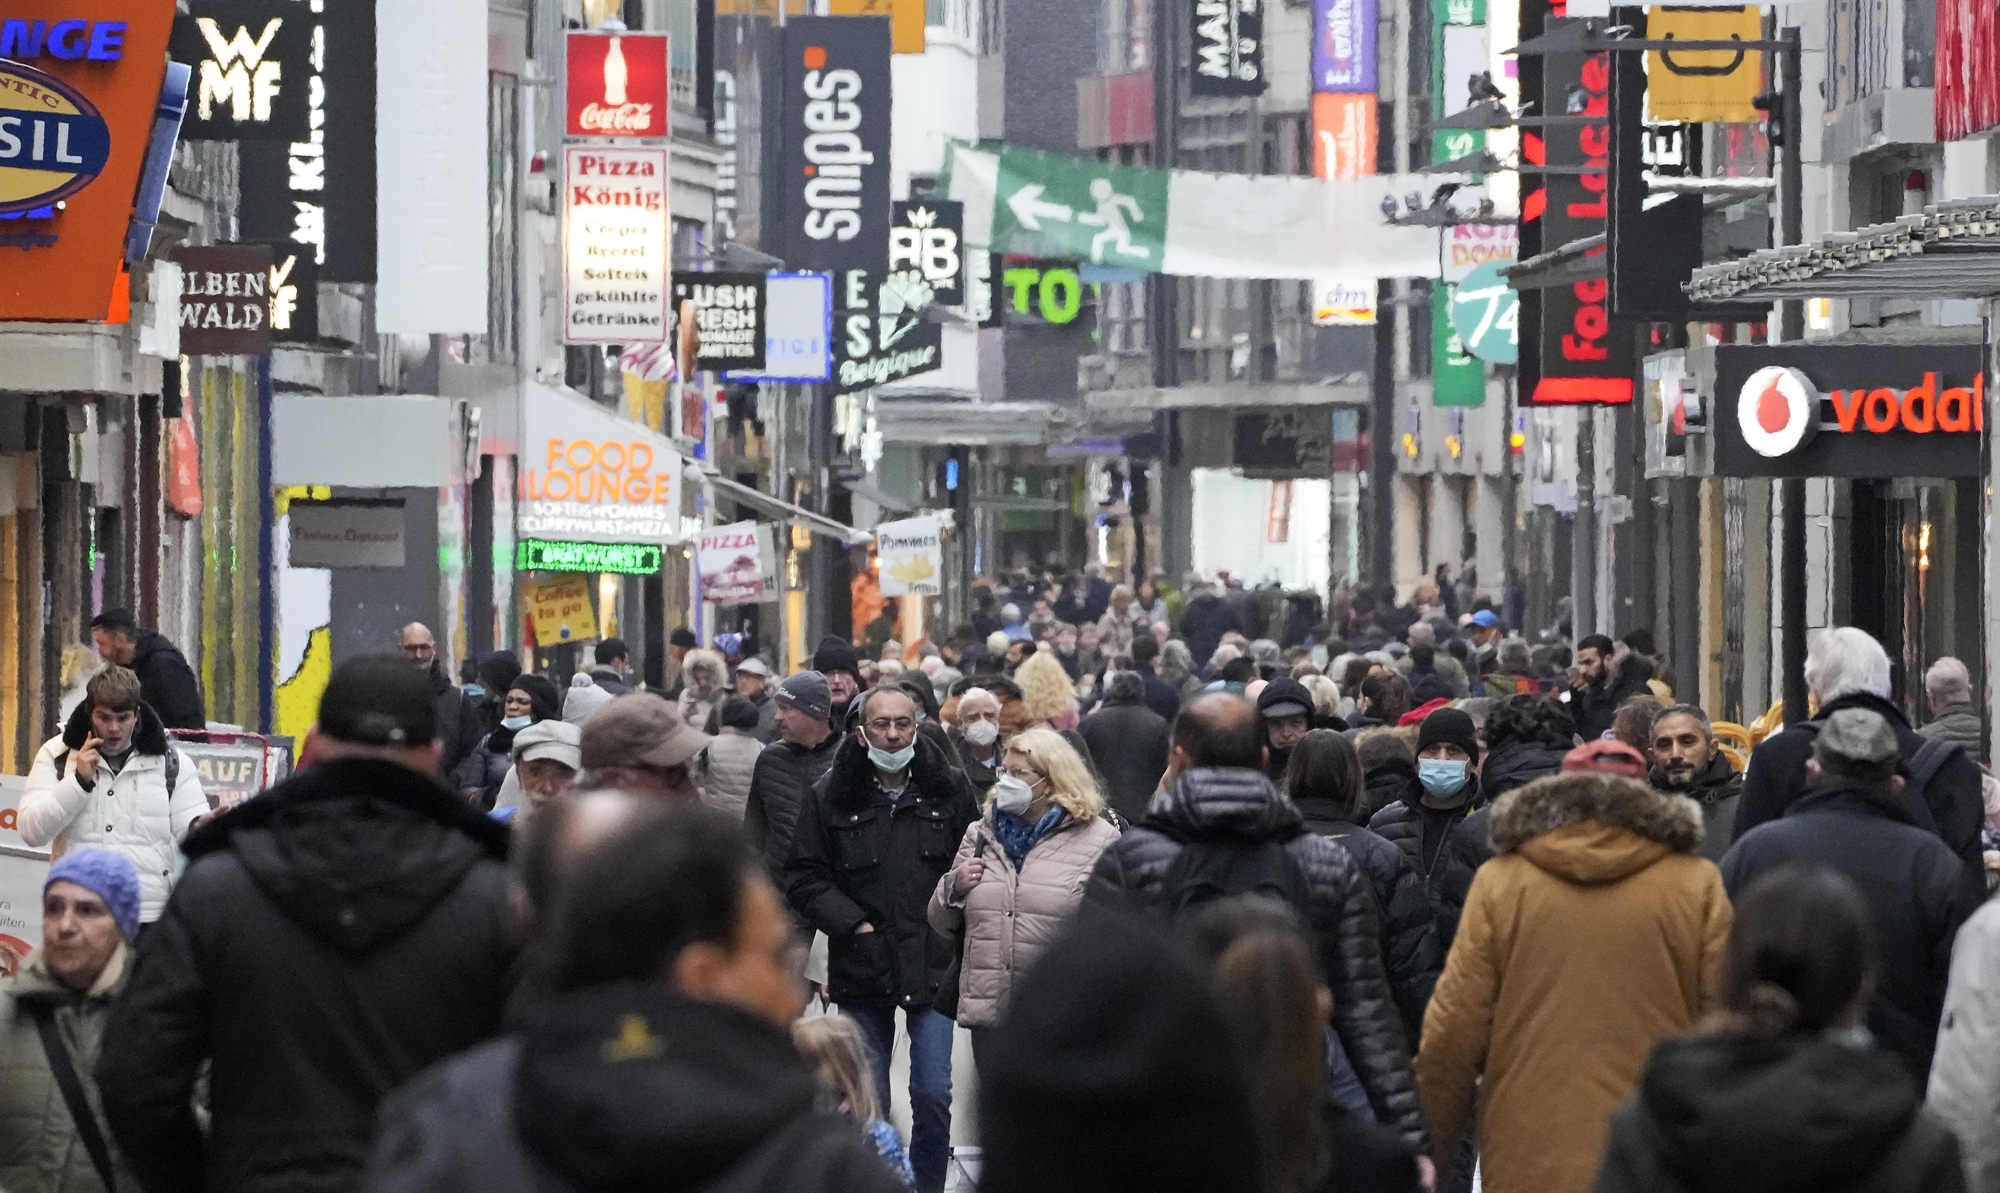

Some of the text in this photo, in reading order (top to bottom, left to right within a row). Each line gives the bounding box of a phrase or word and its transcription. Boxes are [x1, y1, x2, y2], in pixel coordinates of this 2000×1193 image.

[577, 156, 656, 178] Pizza
[573, 185, 662, 212] König
[587, 244, 646, 258] Brezel
[583, 267, 649, 282] Softeis
[574, 288, 659, 306] gekühlte
[571, 309, 661, 327] Getränke
[839, 345, 937, 387] Belgique
[546, 437, 654, 473] FOOD
[528, 468, 671, 504] LOUNGE
[700, 533, 756, 552] PIZZA
